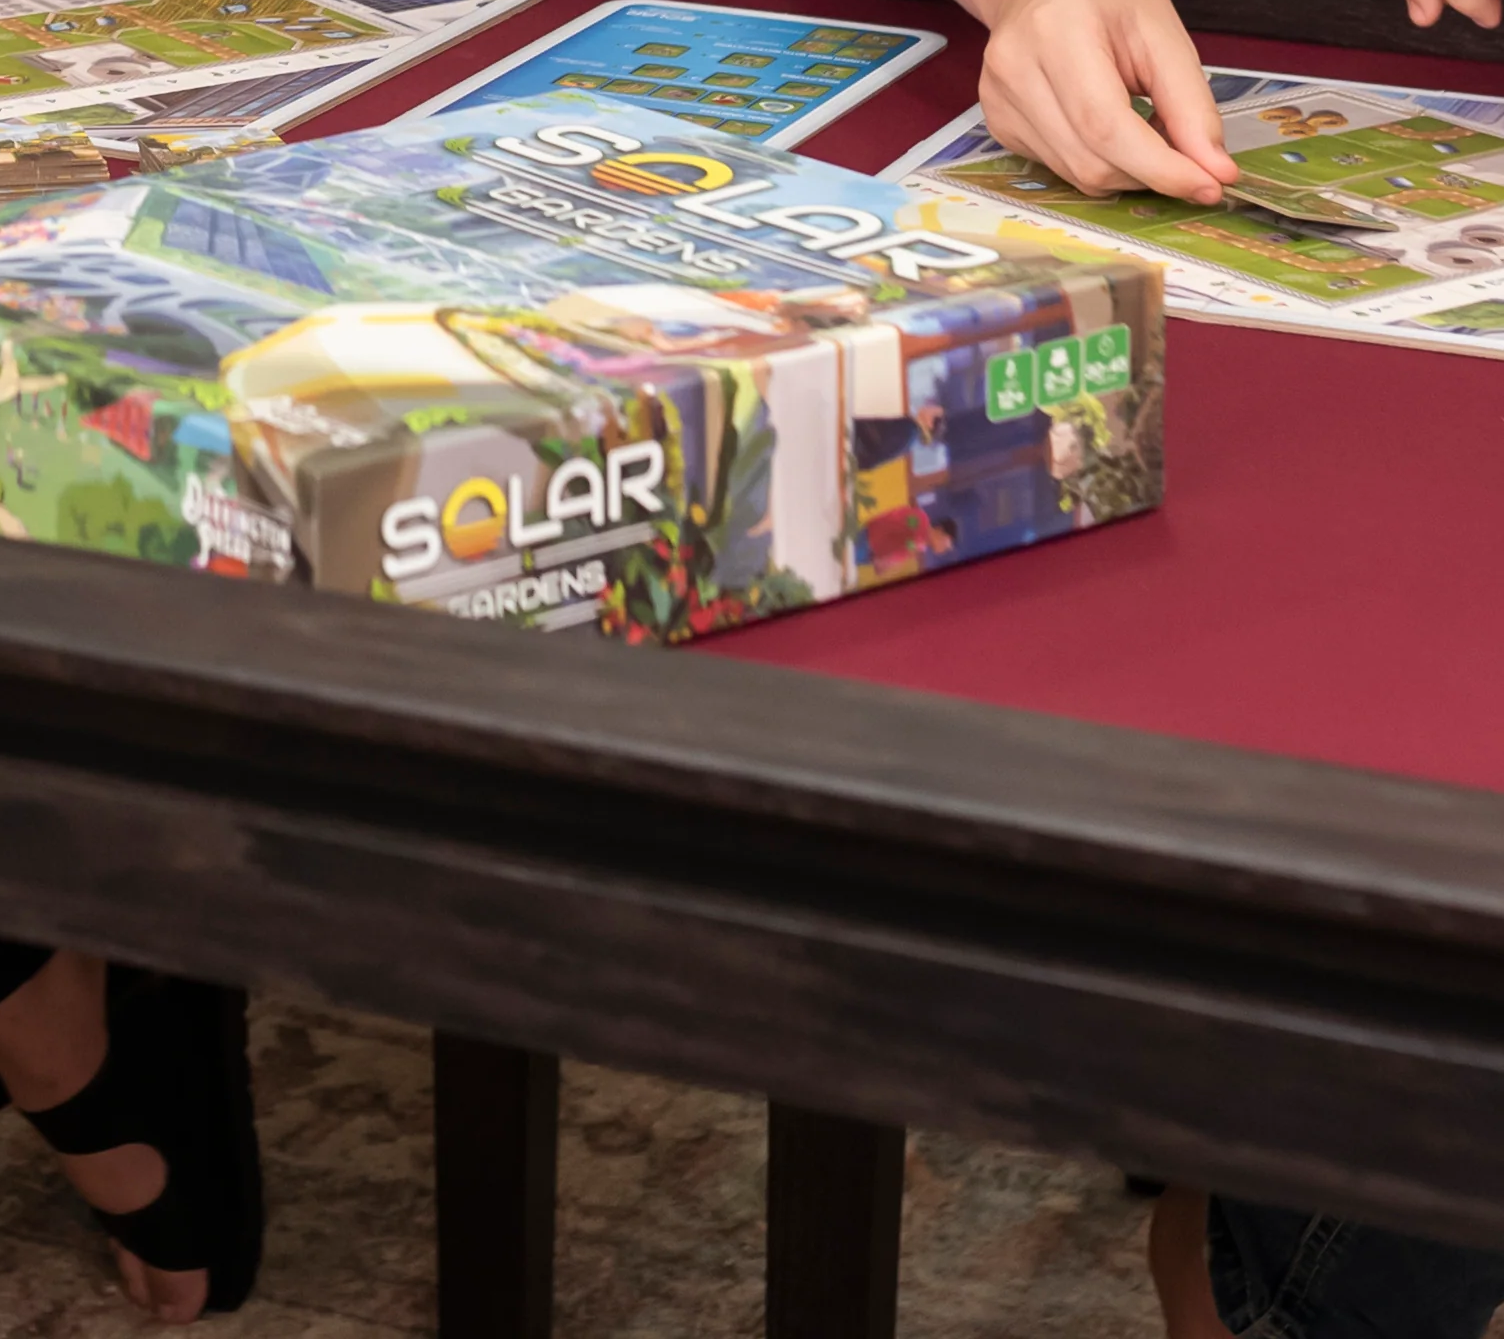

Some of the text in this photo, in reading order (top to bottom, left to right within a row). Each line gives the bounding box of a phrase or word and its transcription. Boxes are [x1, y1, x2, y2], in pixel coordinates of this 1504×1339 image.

[489, 176, 755, 275] GARDENS
[495, 124, 1000, 282] SOLAR
[381, 439, 665, 579] SOLAR
[447, 559, 608, 620] GARDENS
